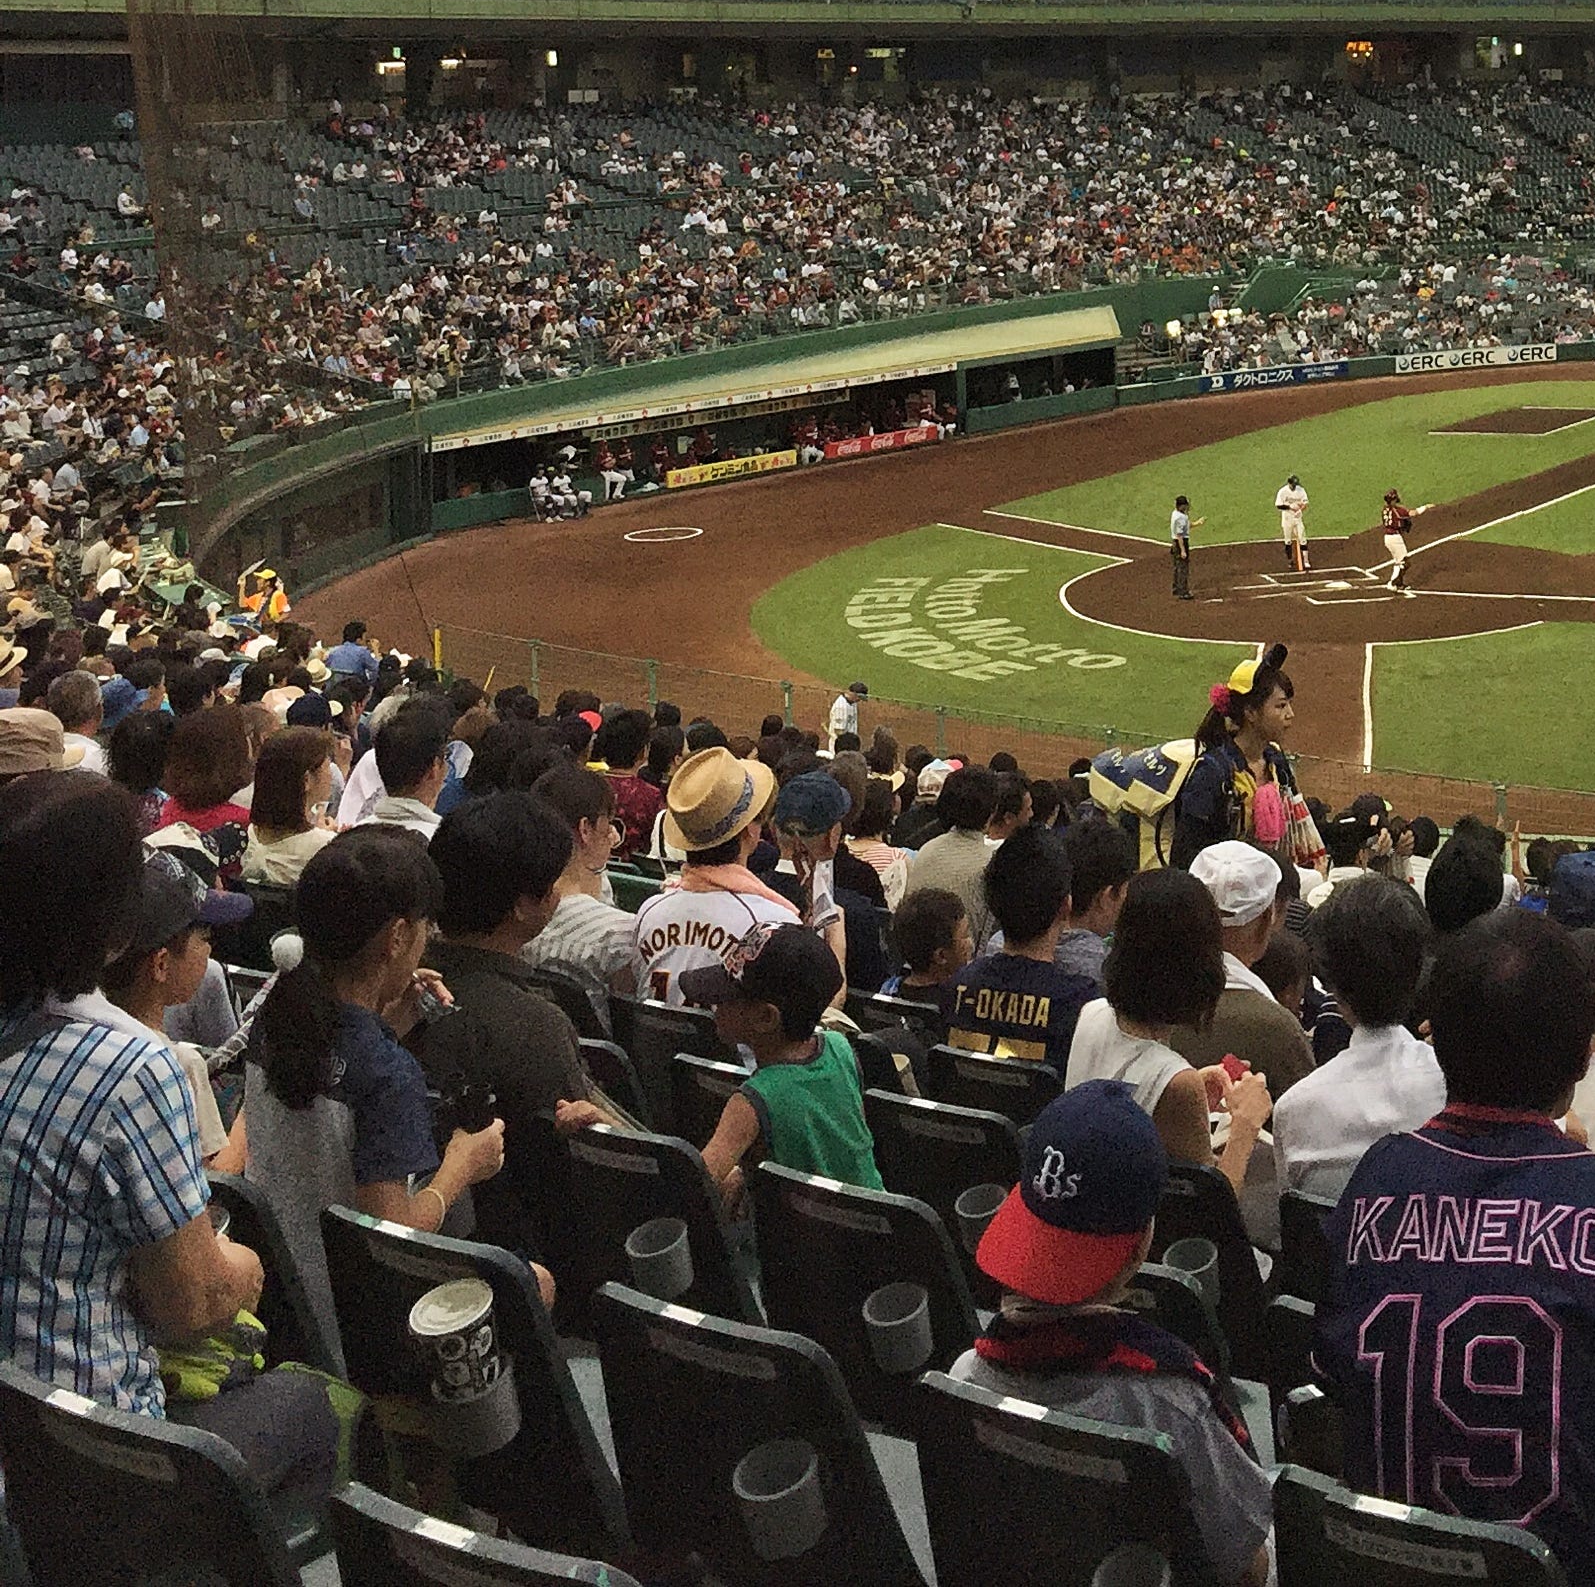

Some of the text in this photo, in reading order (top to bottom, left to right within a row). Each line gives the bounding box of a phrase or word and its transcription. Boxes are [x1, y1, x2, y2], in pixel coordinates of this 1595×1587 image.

[1411, 354, 1444, 370] ERC
[1462, 350, 1495, 365] ERC
[1519, 346, 1554, 361] ERC
[1233, 369, 1295, 388] ダクトロニクス
[844, 577, 1038, 682] FIELD KOBE
[640, 920, 740, 966] NORIMOT
[955, 984, 1050, 1028] T-OKADA
[1033, 1145, 1082, 1201] Bs
[1357, 1294, 1563, 1525] 19
